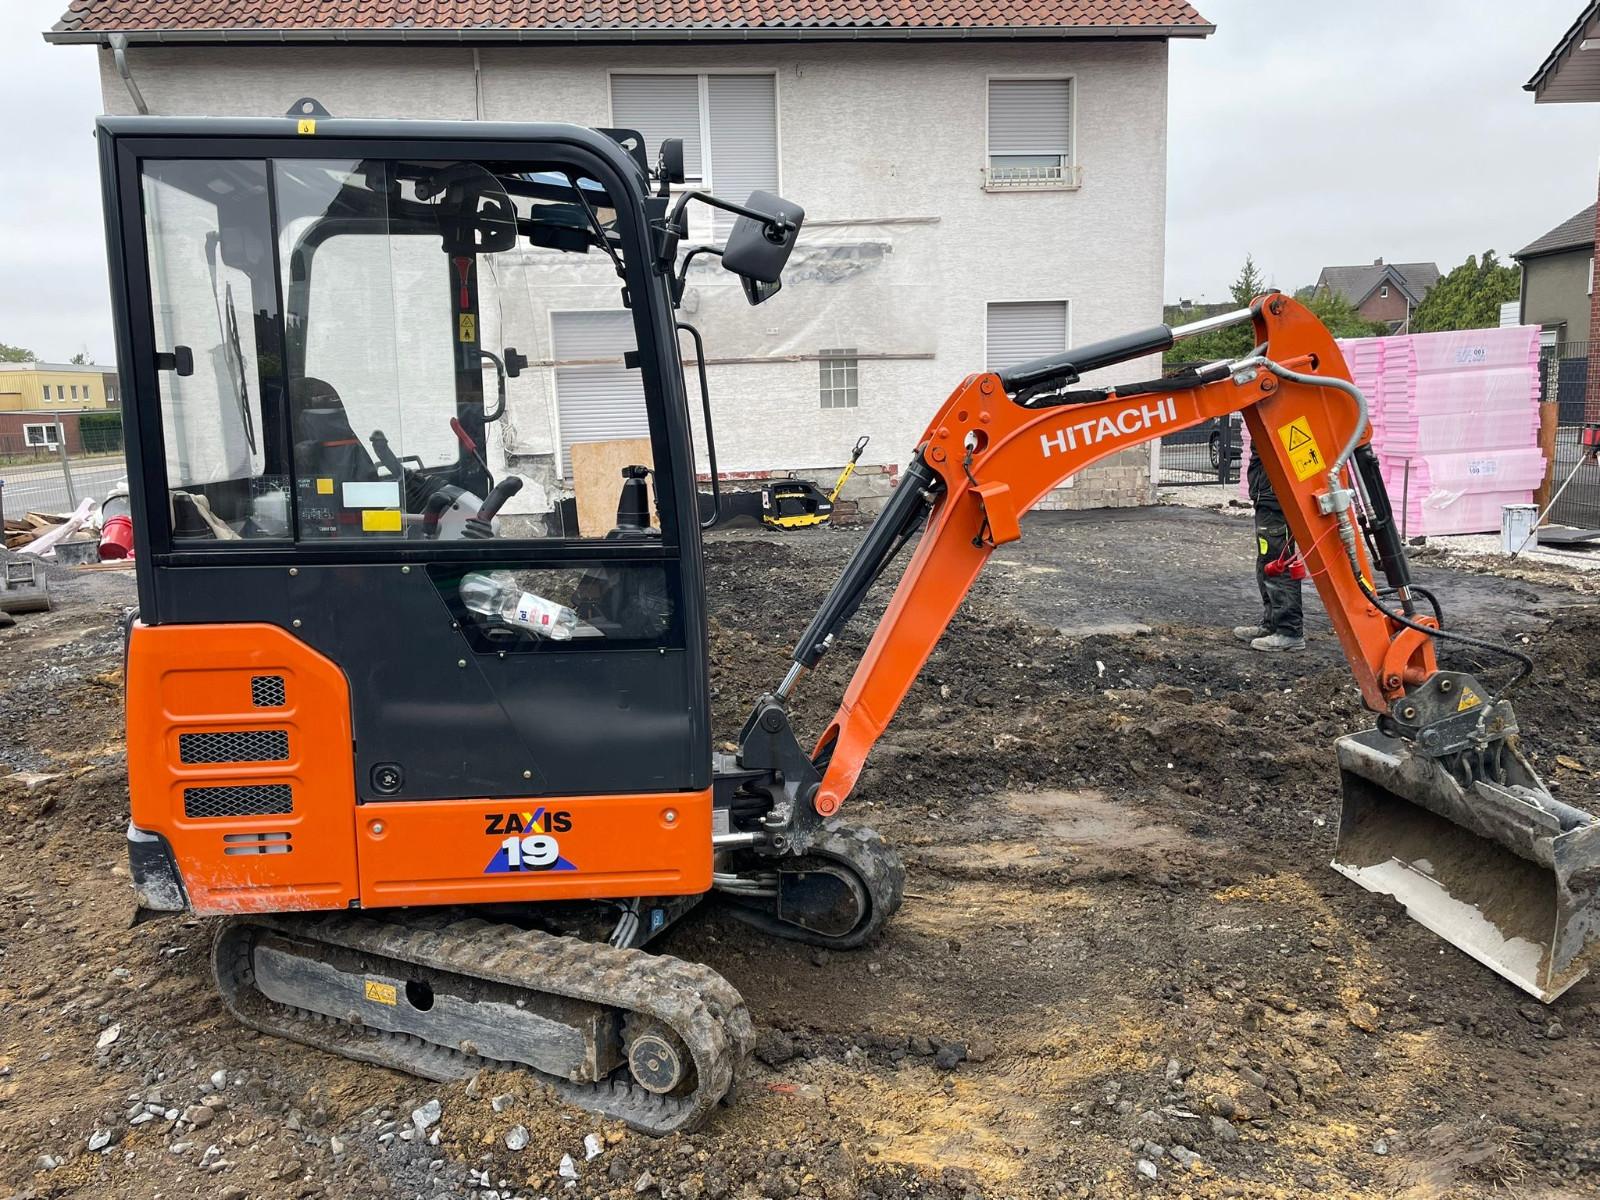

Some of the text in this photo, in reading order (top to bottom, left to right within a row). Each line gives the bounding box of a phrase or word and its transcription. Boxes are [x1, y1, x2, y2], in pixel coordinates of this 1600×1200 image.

[1040, 398, 1177, 457] HITACHI
[519, 610, 529, 622] ja!
[485, 808, 572, 835] ZAXIS
[501, 836, 560, 871] 19
